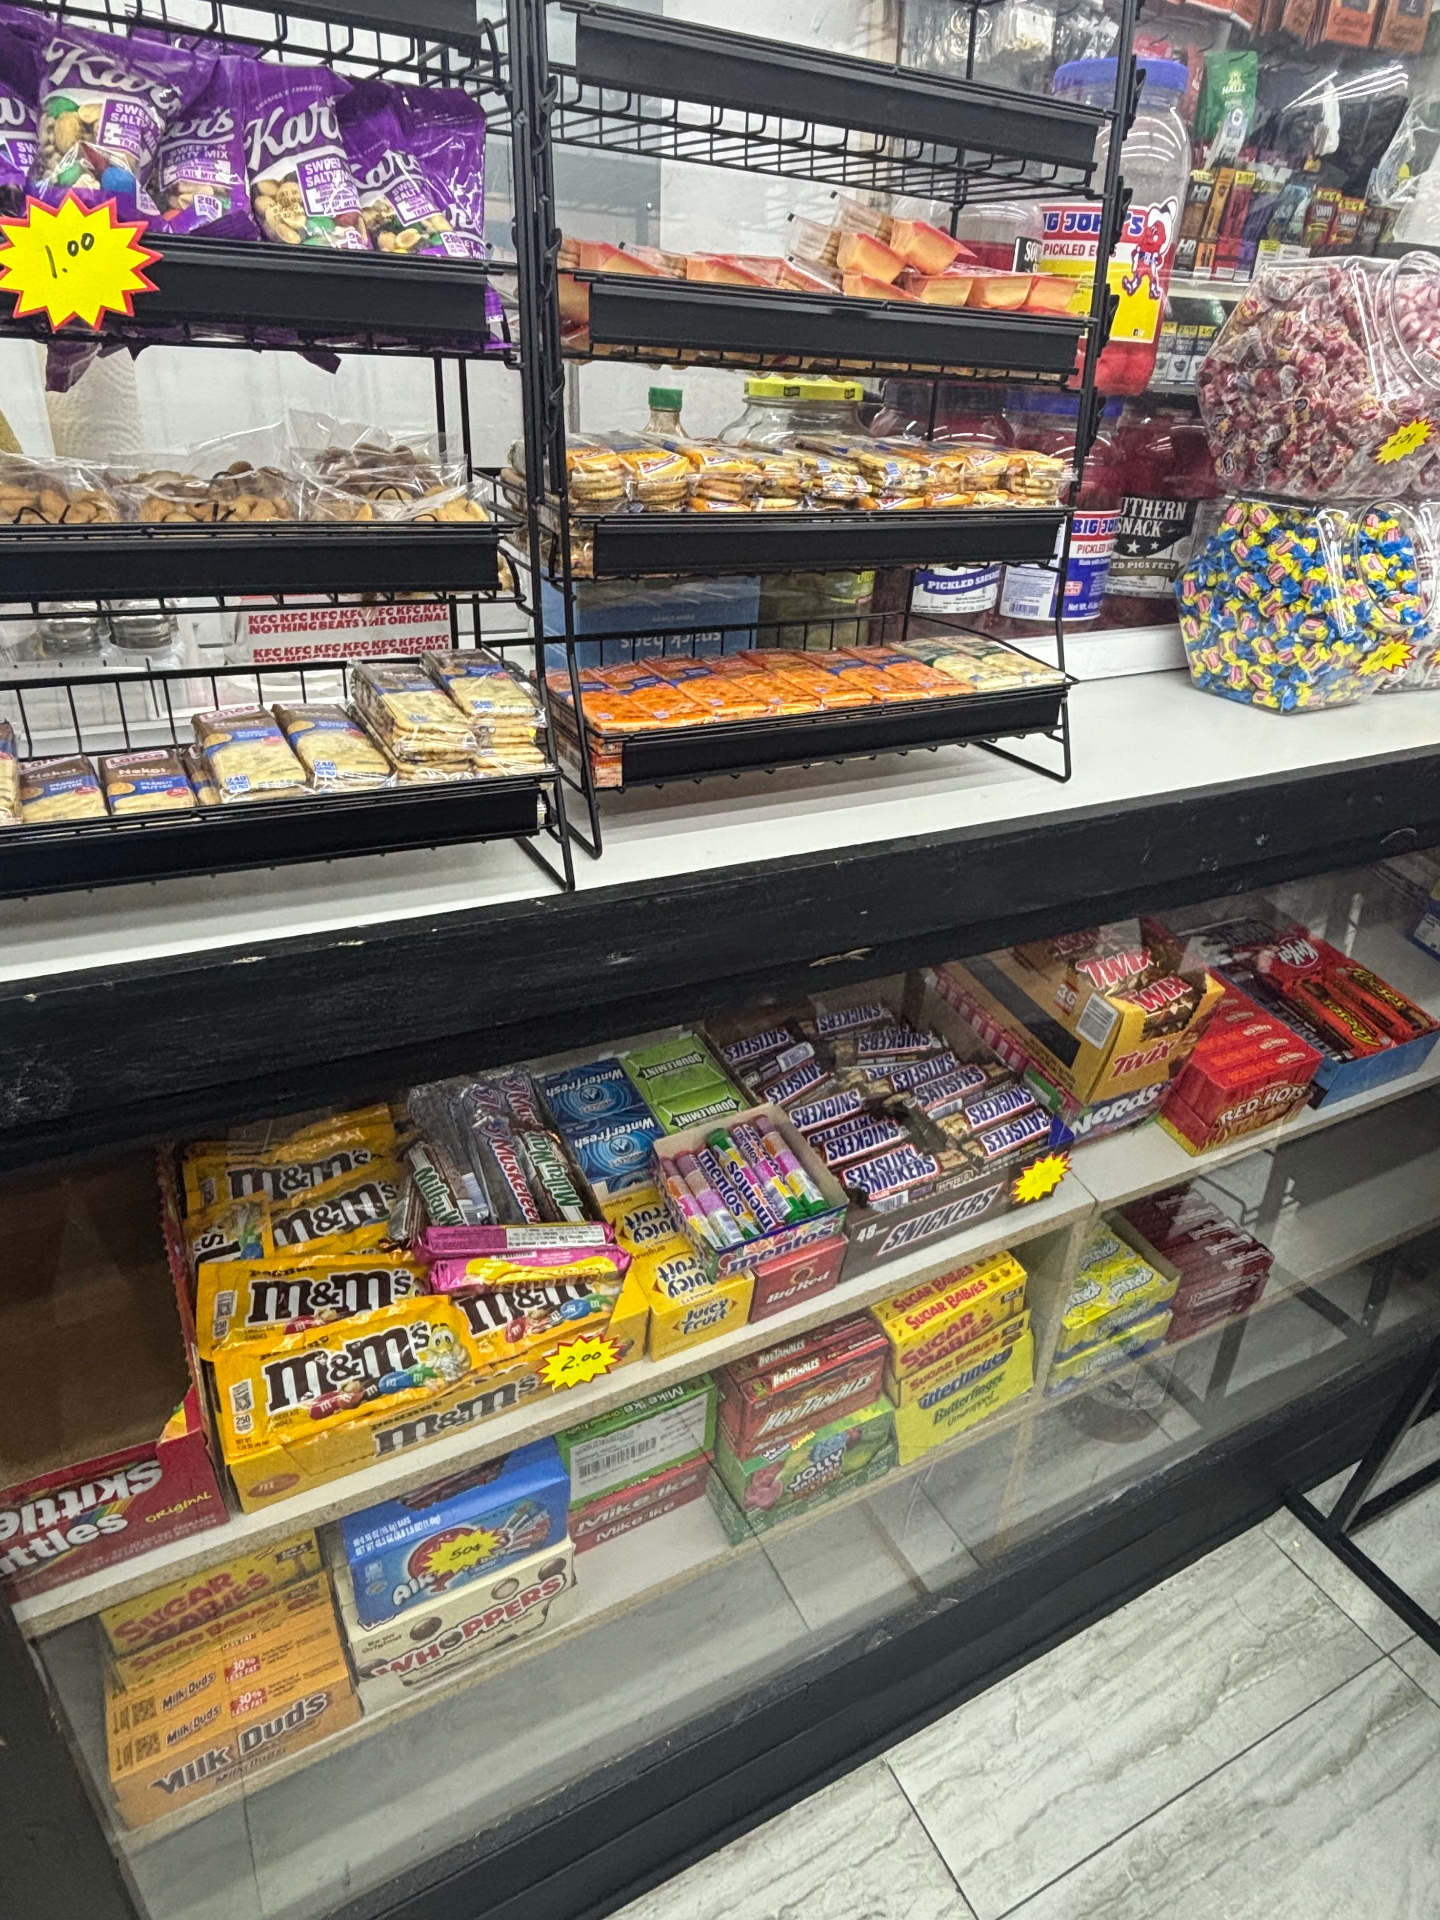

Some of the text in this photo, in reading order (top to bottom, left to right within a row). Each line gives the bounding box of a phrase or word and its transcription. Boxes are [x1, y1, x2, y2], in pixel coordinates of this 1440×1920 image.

[1221, 83, 1246, 94] HALLS
[1043, 211, 1062, 233] IG
[1042, 243, 1086, 257] PICKLED
[1071, 519, 1098, 535] BIG
[1118, 517, 1162, 538] SNACK
[1076, 543, 1106, 555] PICKLED
[1127, 561, 1151, 570] PIGS
[928, 579, 974, 591] PICKLED
[249, 603, 448, 625] KFC KFC KFC KFC KFC
[249, 611, 449, 635] NOTHING BEATS ORIGINAL
[253, 634, 450, 658] KFC KFC KFC KFC KFC KFC KFC
[107, 750, 165, 767] Lance
[117, 766, 168, 776] Nekot
[315, 760, 335, 768] 240
[226, 776, 248, 784] 240
[1077, 947, 1152, 990] TWIX
[817, 1002, 884, 1034] SNICKERS
[726, 1028, 791, 1062] SATISFIES
[642, 1052, 703, 1079] DOUBLEMINT
[546, 1068, 625, 1097] Winterfresh
[676, 1099, 738, 1127] DOUBLEMINT
[788, 1089, 863, 1132] SNICKERS
[965, 1085, 1036, 1130] SNICKERS
[1218, 1094, 1261, 1127] RED
[1264, 1084, 1311, 1108] HOTS
[481, 1121, 511, 1140] 3
[574, 1116, 656, 1149] Winterfresh
[734, 1126, 761, 1164] mentos
[825, 1119, 902, 1167] SNICKERS
[980, 1108, 1053, 1156] SATISFIES
[227, 1149, 373, 1202] m&m's
[414, 1166, 451, 1216] Milky
[542, 1163, 583, 1208] Milky
[697, 1148, 746, 1218] mentos
[859, 1154, 940, 1197] SNICKERS
[726, 1160, 775, 1234] mentos
[272, 1180, 398, 1249] m&m's
[623, 1201, 674, 1229] Fruit
[883, 1186, 1000, 1254] SNICKERS
[632, 1219, 679, 1244] Juicy
[856, 1224, 877, 1242] 48
[632, 1244, 667, 1261] original
[728, 1225, 835, 1272] mentos
[246, 1268, 412, 1327] m&m's
[766, 1270, 832, 1305] Big Red
[892, 1263, 974, 1311] SUGAR BABIES
[682, 1297, 730, 1325] Juicy
[904, 1278, 990, 1331] SUGAR BABIES
[214, 1319, 229, 1333] 250
[683, 1310, 728, 1336] Fruit
[900, 1311, 976, 1368] SUGAR
[758, 1340, 806, 1368] HOT TAMALES
[917, 1312, 994, 1369] BABIES
[263, 1320, 432, 1416] m&m's
[560, 1349, 603, 1373] 2.00
[771, 1357, 821, 1388] HOT TAMALES
[909, 1361, 954, 1392] SUGAR
[648, 1385, 685, 1406] Mike
[757, 1371, 877, 1438] HOT TAMALES
[933, 1370, 1007, 1425] Butterfinger
[235, 1414, 252, 1427] 250
[375, 1373, 539, 1458] m&m's
[788, 1448, 846, 1488] JOLLY
[0, 1459, 164, 1542] Skittle
[576, 1473, 698, 1533] Mike Ike
[595, 1501, 676, 1543] Mike Ike
[449, 1542, 482, 1562] 50¢
[114, 1571, 234, 1641] SUGAR
[146, 1572, 271, 1650] BABIES
[376, 1574, 565, 1676] WHOPPERS
[162, 1656, 256, 1711] Milk Duds 30%
[225, 1664, 259, 1684] LESS FAT
[165, 1690, 263, 1746] Milk Duds 30%
[231, 1696, 265, 1718] LESS FAT
[148, 1692, 330, 1795] Milk Duds
